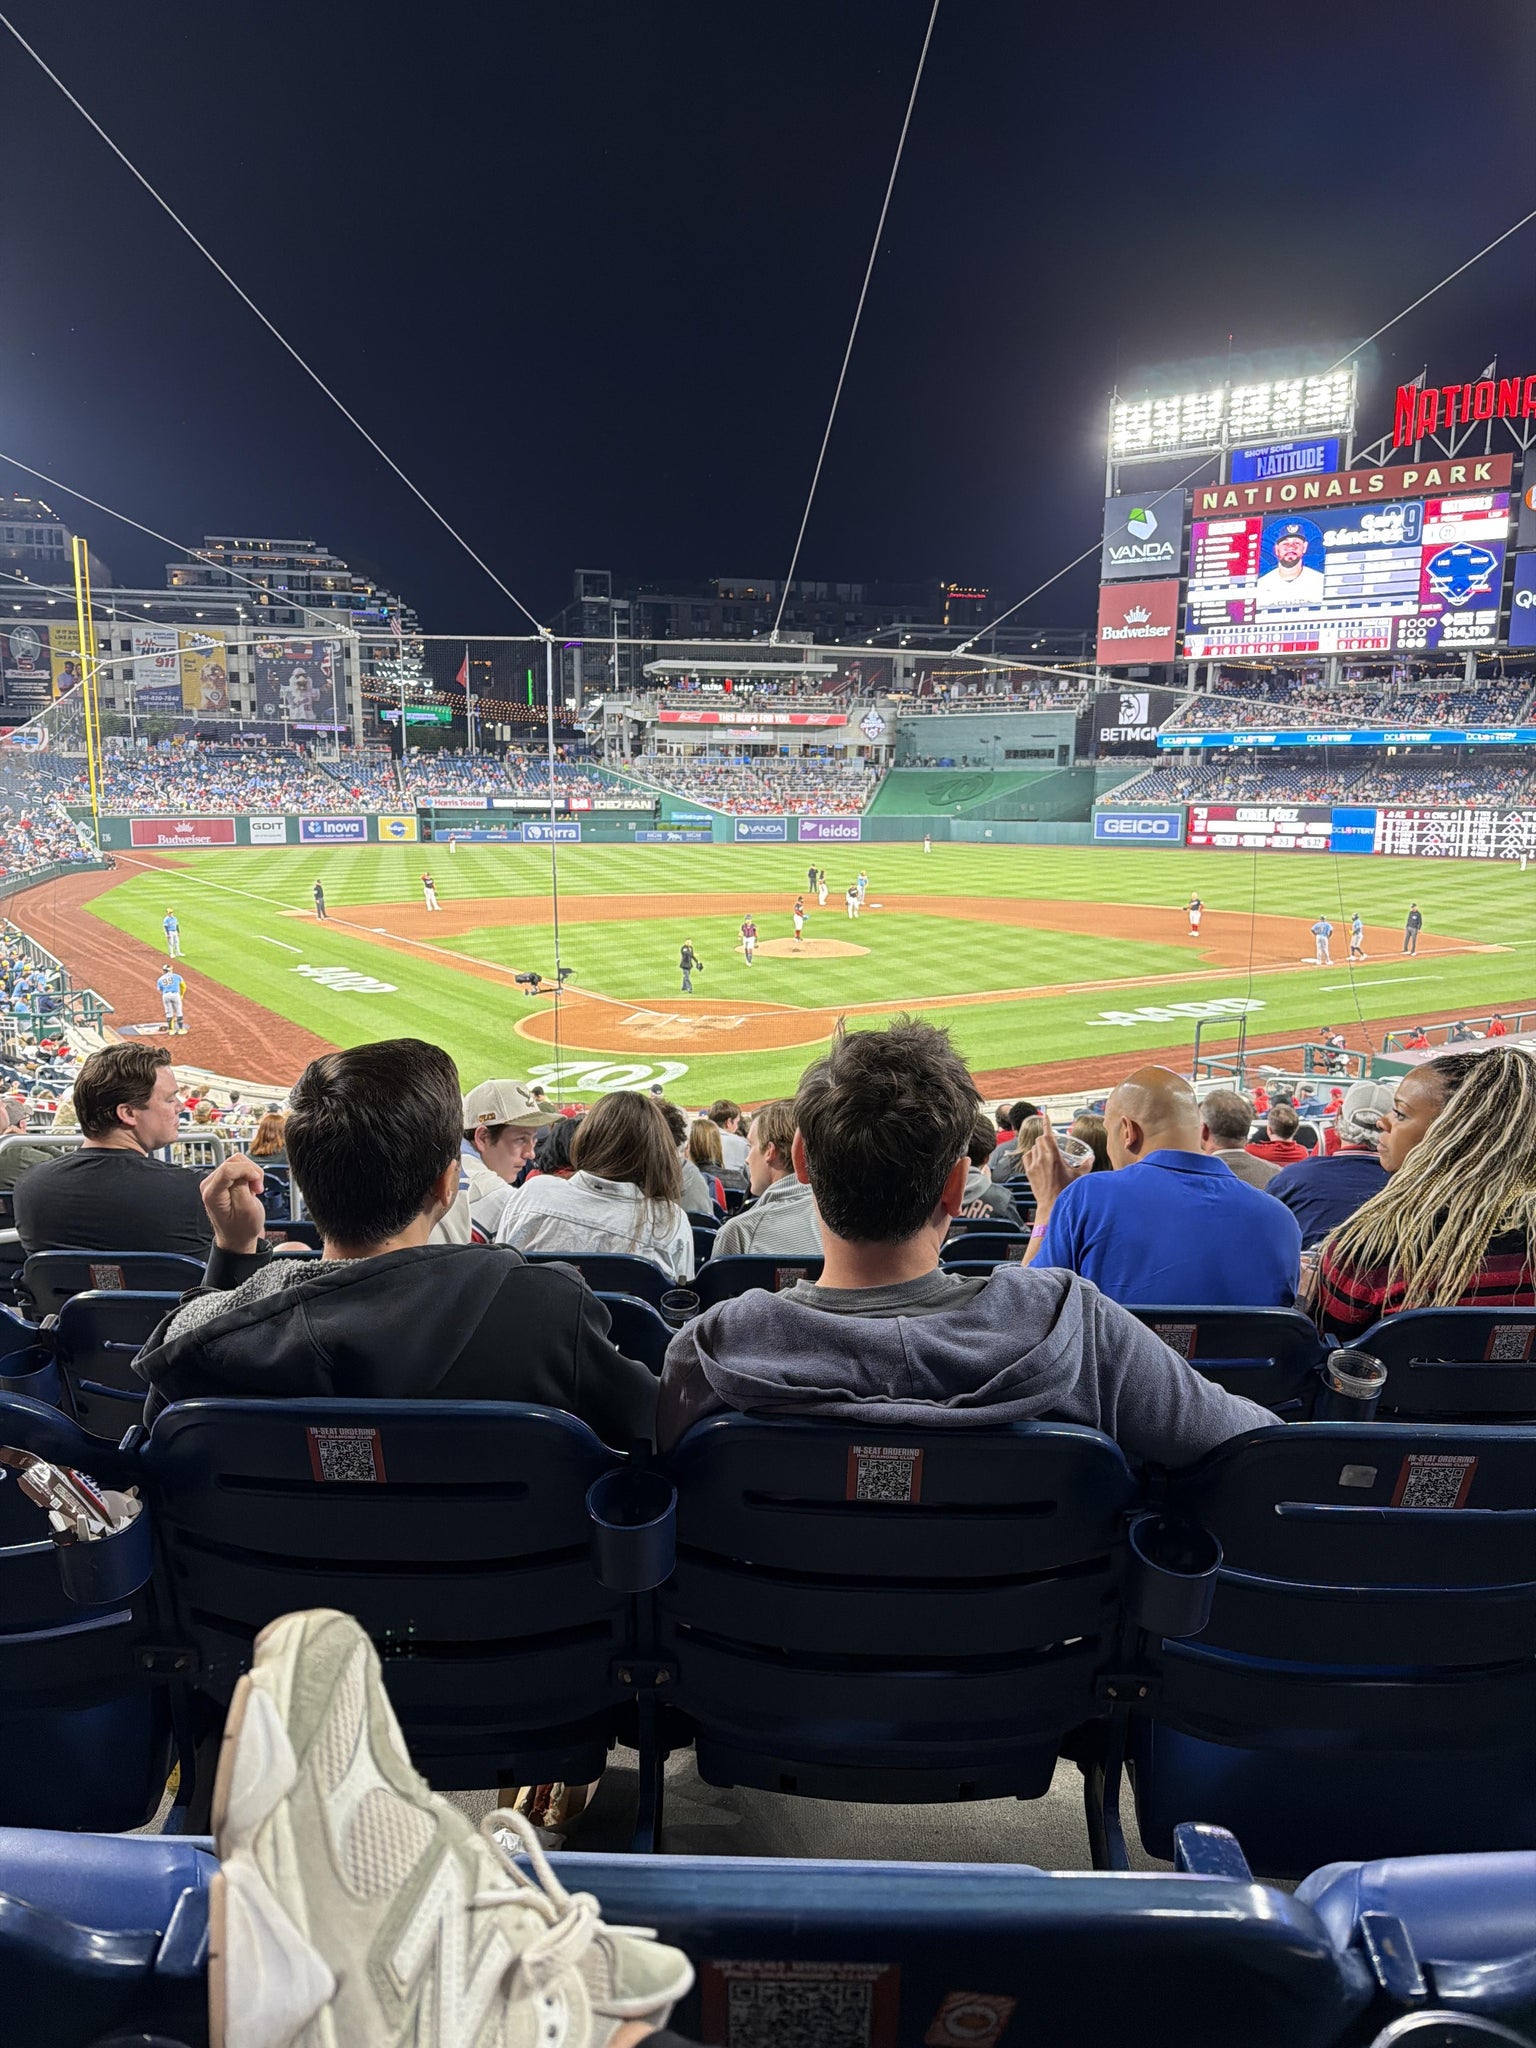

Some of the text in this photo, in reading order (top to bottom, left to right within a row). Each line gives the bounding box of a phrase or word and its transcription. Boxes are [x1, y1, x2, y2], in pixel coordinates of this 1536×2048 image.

[1257, 446, 1324, 477] NATITUDE
[1202, 462, 1491, 510] NATIONALS PARK
[1108, 541, 1175, 560] VANDA
[1101, 625, 1171, 640] Budweiser
[155, 657, 176, 668] 911
[434, 799, 459, 807] Harris
[460, 799, 485, 807] Teeter
[623, 800, 651, 809] FAN
[251, 822, 284, 830] GDIT
[323, 821, 359, 833] Inova
[749, 824, 783, 833] VANDA
[818, 824, 858, 837] leidos
[1103, 818, 1170, 834] GEICO
[540, 828, 577, 838] Terra
[157, 834, 212, 844] Budweiser
[310, 1427, 376, 1436] IN-SEAT ORDERING
[853, 1446, 920, 1457] IN-SEAT ORDERING
[1408, 1454, 1476, 1463] IN-SEAT ORDERING
